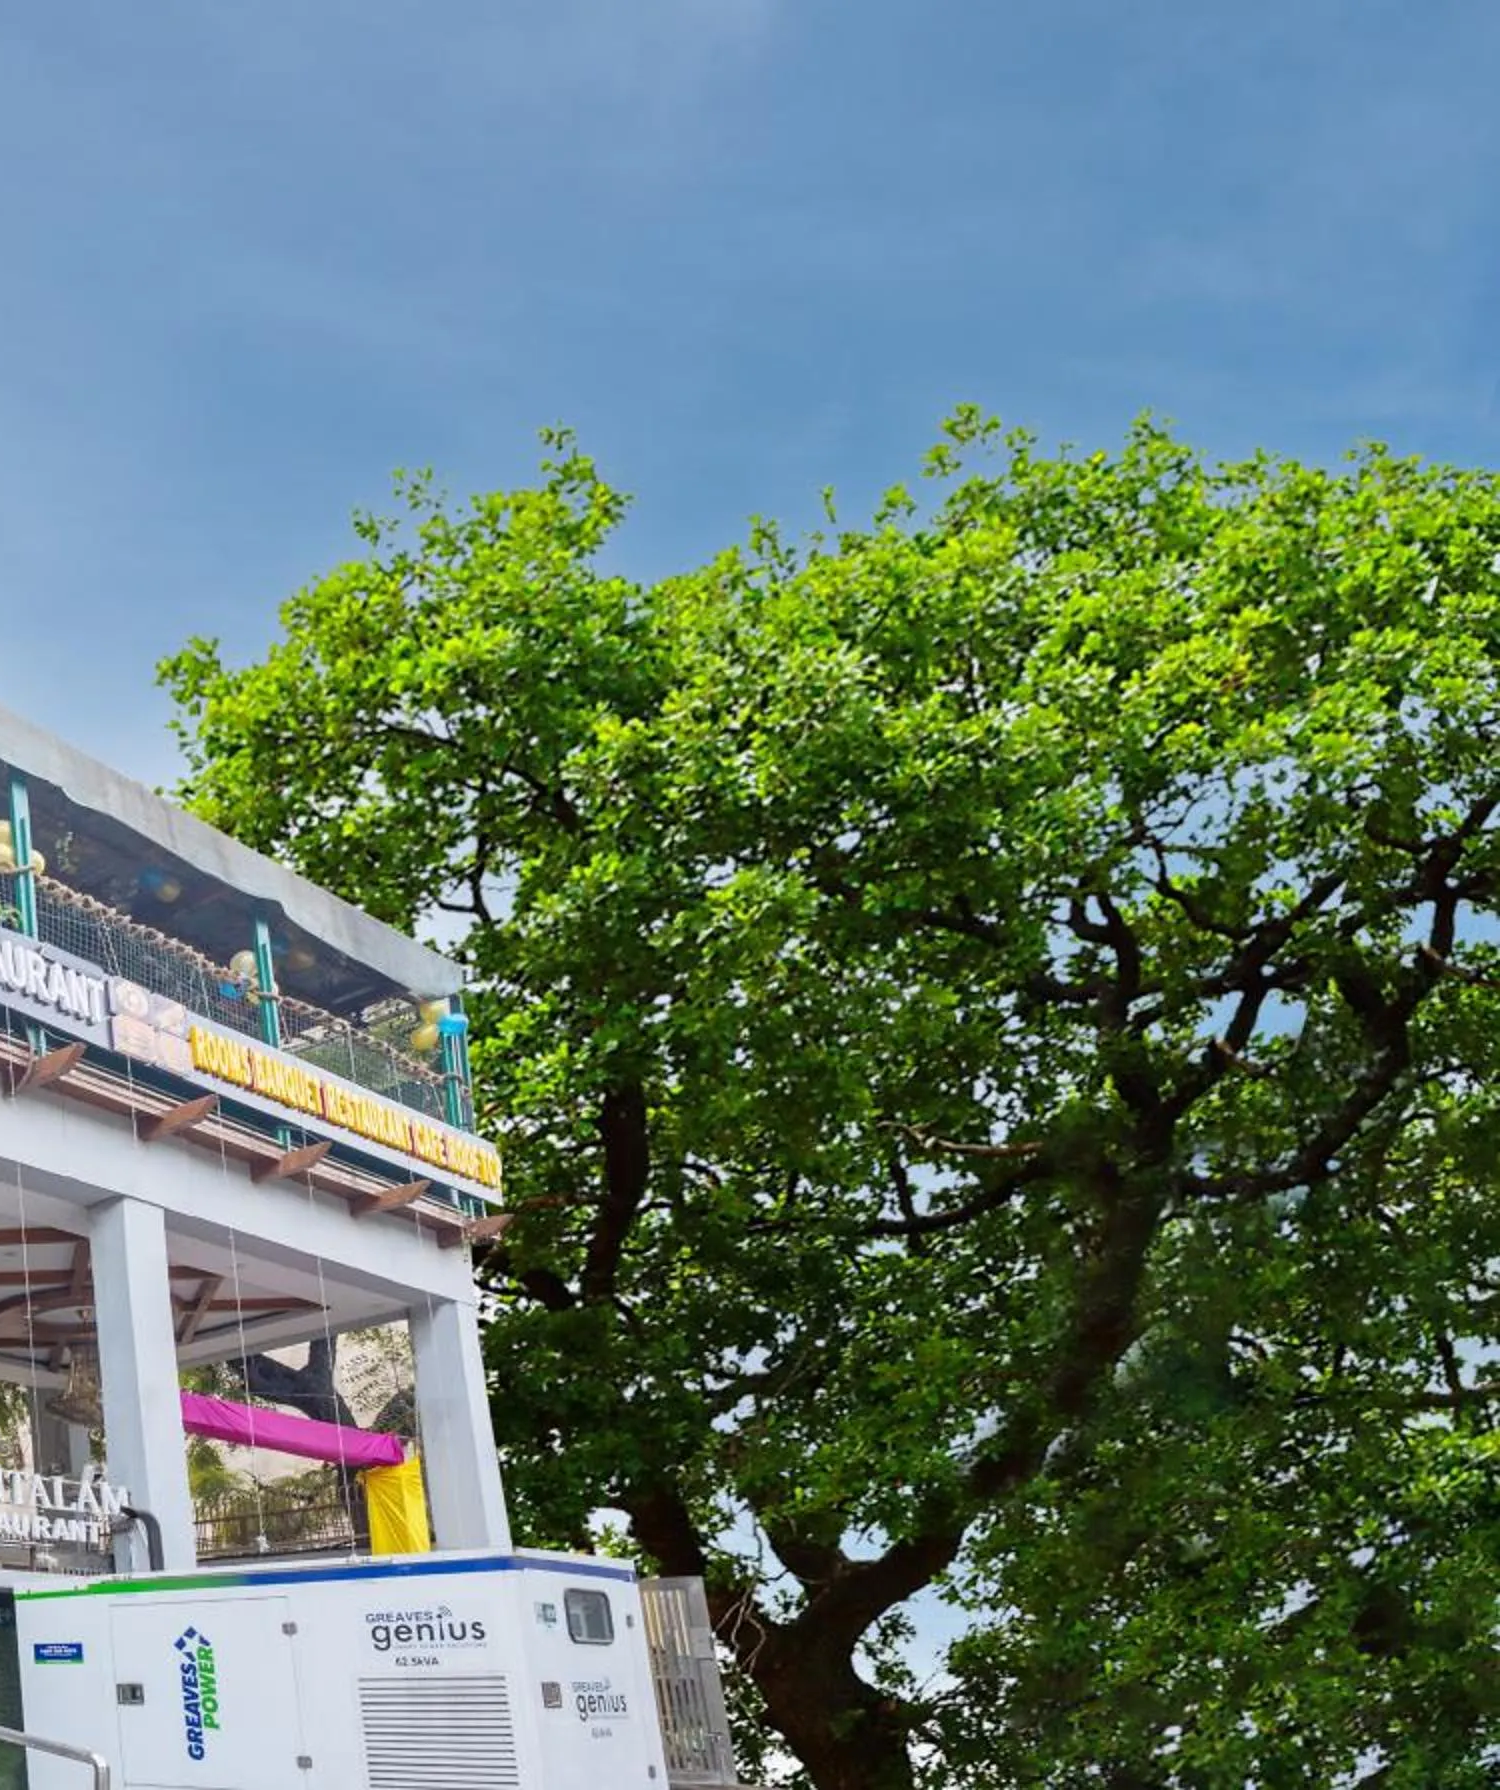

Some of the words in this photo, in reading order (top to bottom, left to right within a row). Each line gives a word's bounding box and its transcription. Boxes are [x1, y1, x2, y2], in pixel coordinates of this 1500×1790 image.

[365, 1611, 433, 1623] GREAVES
[371, 1614, 486, 1651] genius
[197, 1645, 220, 1730] POWER
[180, 1662, 205, 1761] GREAVES
[575, 1694, 627, 1722] genius
